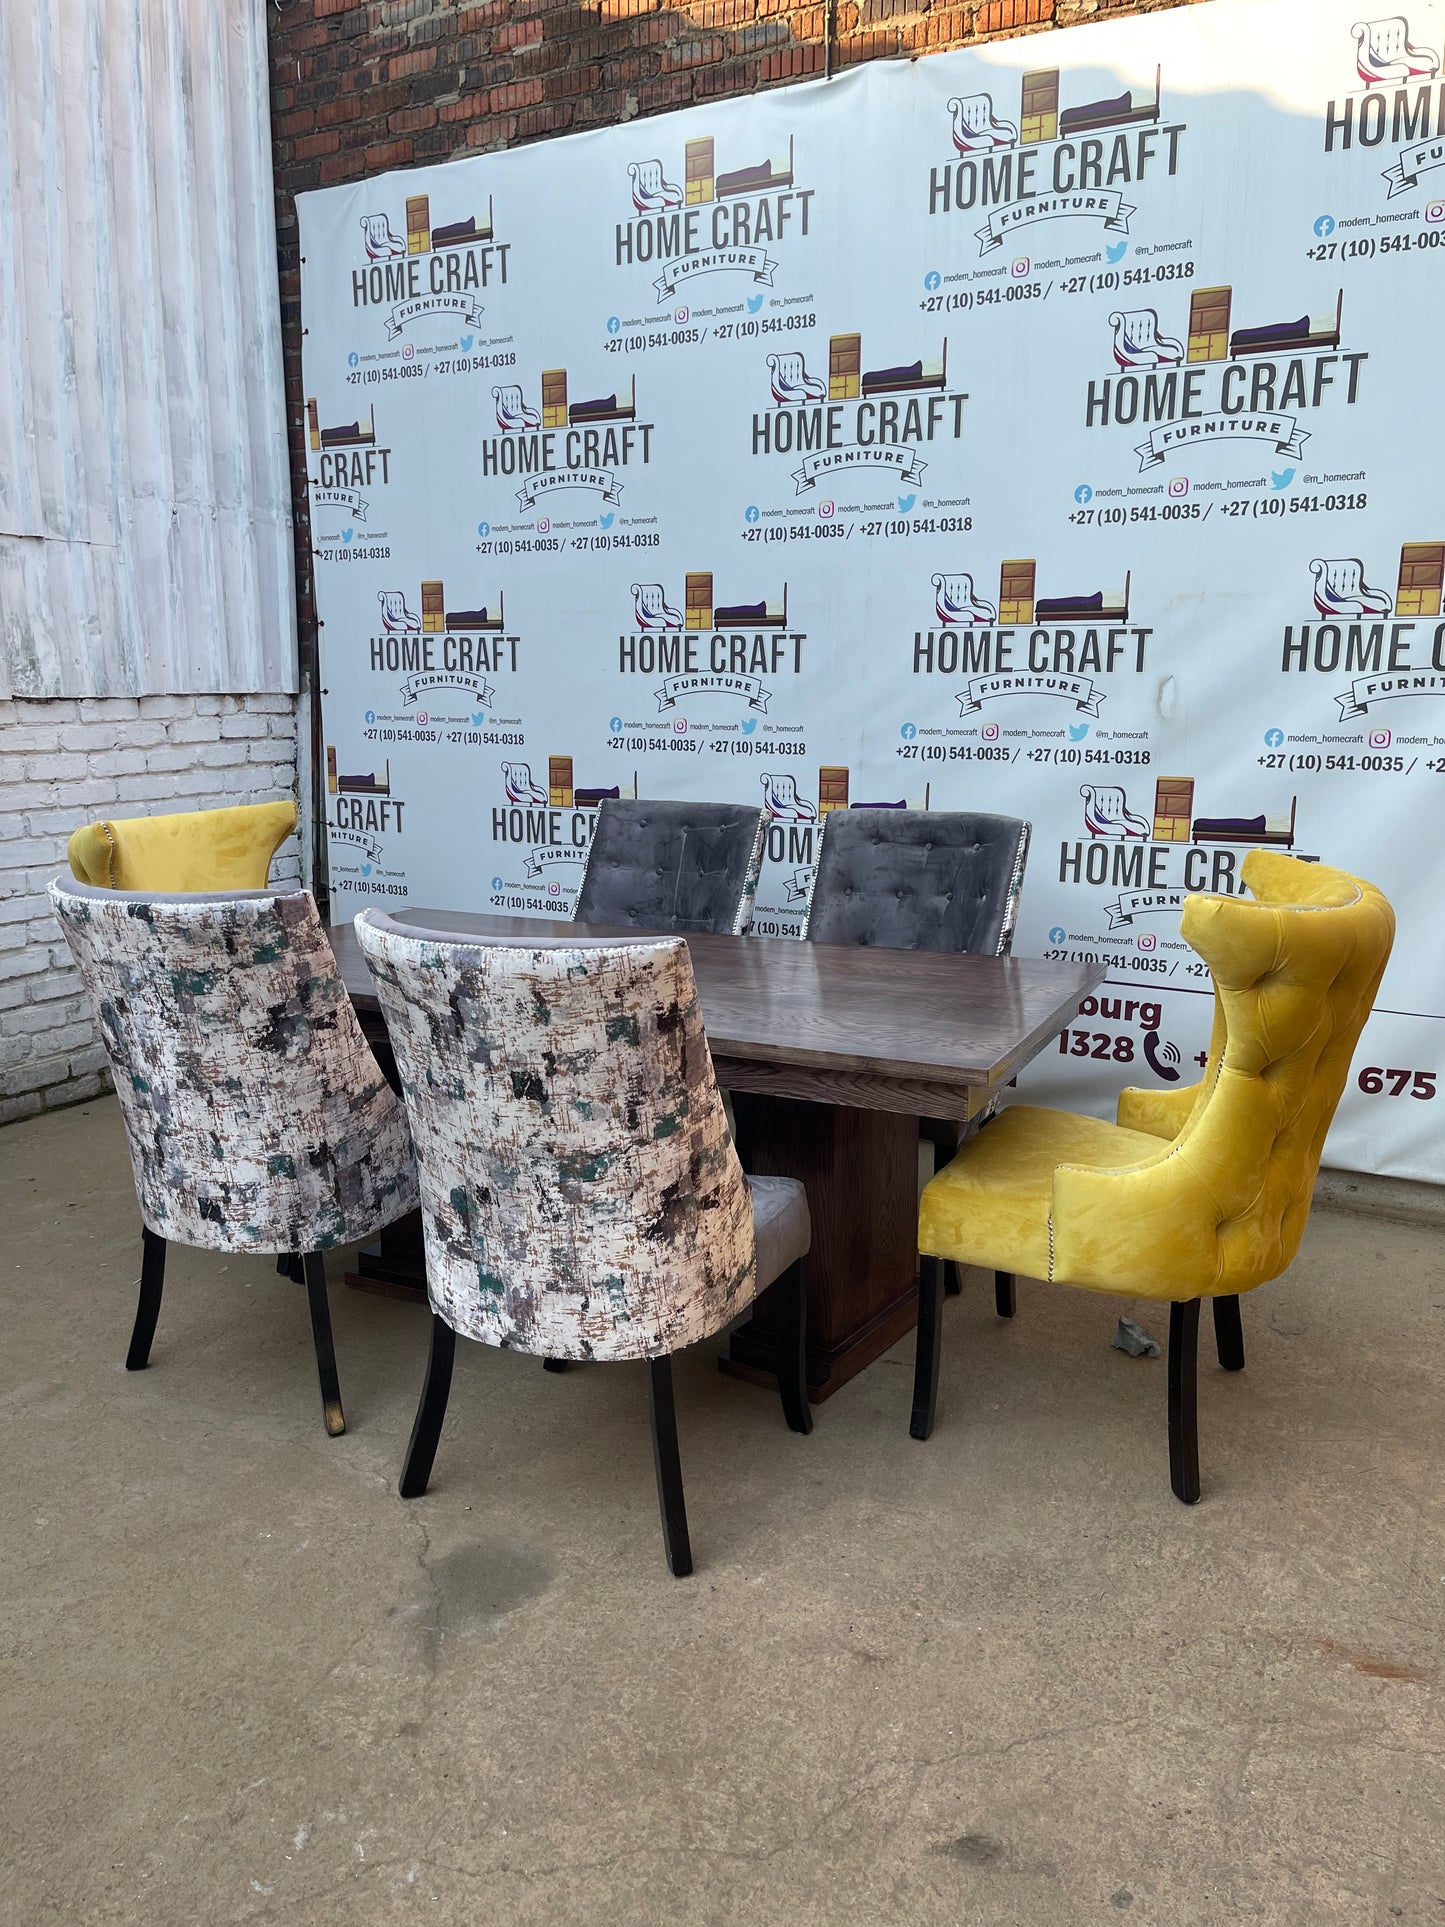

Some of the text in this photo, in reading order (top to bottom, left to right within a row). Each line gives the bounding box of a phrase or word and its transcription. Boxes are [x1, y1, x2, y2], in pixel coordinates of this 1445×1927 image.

[929, 124, 1187, 214] HOME CRAFT
[1001, 198, 1108, 226] FURNITURE
[616, 190, 814, 266] HOME CRAFT
[1306, 243, 1337, 260] +27
[1341, 238, 1376, 261] (10)
[353, 244, 510, 307] HOME CRAFT
[673, 254, 756, 277] FURNITURE
[919, 296, 943, 312] +27
[947, 292, 973, 312] (10)
[976, 283, 1041, 305] 541-0035
[1060, 277, 1086, 293] +27
[1090, 272, 1119, 293] (10)
[1123, 261, 1194, 286] 541-0318
[400, 299, 466, 318] FURNITURE
[604, 339, 622, 352] +27
[625, 336, 645, 353] (10)
[649, 329, 698, 347] 541-0035
[712, 324, 732, 338] +27
[736, 321, 758, 339] (10)
[762, 313, 815, 333] 541-0318
[1086, 352, 1369, 427] HOME CRAFT
[753, 394, 969, 455] HOME CRAFT
[1163, 420, 1281, 444] FURNITURE
[483, 424, 654, 476] HOME CRAFT
[813, 451, 904, 470] FURNITURE
[320, 449, 391, 488] CRAFT
[533, 474, 605, 490] FURNITURE
[1069, 510, 1095, 525] +27
[1098, 508, 1126, 527] (10)
[1130, 504, 1200, 521] 541-0035
[1221, 501, 1249, 516] +27
[1253, 498, 1285, 518] (10)
[1289, 493, 1367, 513] 541-0318
[741, 529, 762, 541] +27
[765, 527, 786, 543] (10)
[790, 524, 844, 539] 541-0035
[860, 522, 882, 535] +27
[885, 520, 909, 537] (10)
[913, 517, 972, 533] 541-0318
[335, 548, 351, 562] (10)
[353, 547, 391, 560] 541-0318
[476, 542, 492, 553] +27
[495, 541, 512, 555] (10)
[515, 539, 558, 551] 541-0035
[570, 538, 588, 549] +27
[591, 536, 610, 551] (10)
[613, 534, 659, 548] 541-0318
[370, 637, 520, 672] HOME CRAFT
[620, 634, 806, 674] HOME CRAFT
[913, 629, 1153, 673] HOME CRAFT
[1282, 624, 1415, 672] HOME
[415, 675, 478, 688] FURNITURE
[673, 678, 751, 692] FURNITURE
[980, 678, 1080, 694] FURNITURE
[607, 738, 624, 748] +27
[627, 738, 646, 752] (10)
[649, 739, 695, 752] 541-0035
[709, 741, 728, 752] +27
[731, 741, 752, 756] (10)
[755, 742, 805, 755] 541-0318
[896, 746, 918, 758] +27
[921, 746, 946, 762] (10)
[949, 747, 1009, 761] 541-0035
[1027, 749, 1051, 761] +27
[1054, 749, 1081, 766] (10)
[1085, 750, 1150, 765] 541-0318
[1257, 755, 1286, 768] +27
[1290, 754, 1321, 773] (10)
[1325, 755, 1403, 772] 541-0035
[337, 797, 405, 833] CRAFT
[492, 807, 562, 845] HOME
[540, 850, 588, 861] FURNIT
[1059, 841, 1170, 889] HOME
[371, 883, 408, 896] 541-0318
[489, 895, 569, 913] +27 (10) 541-0035
